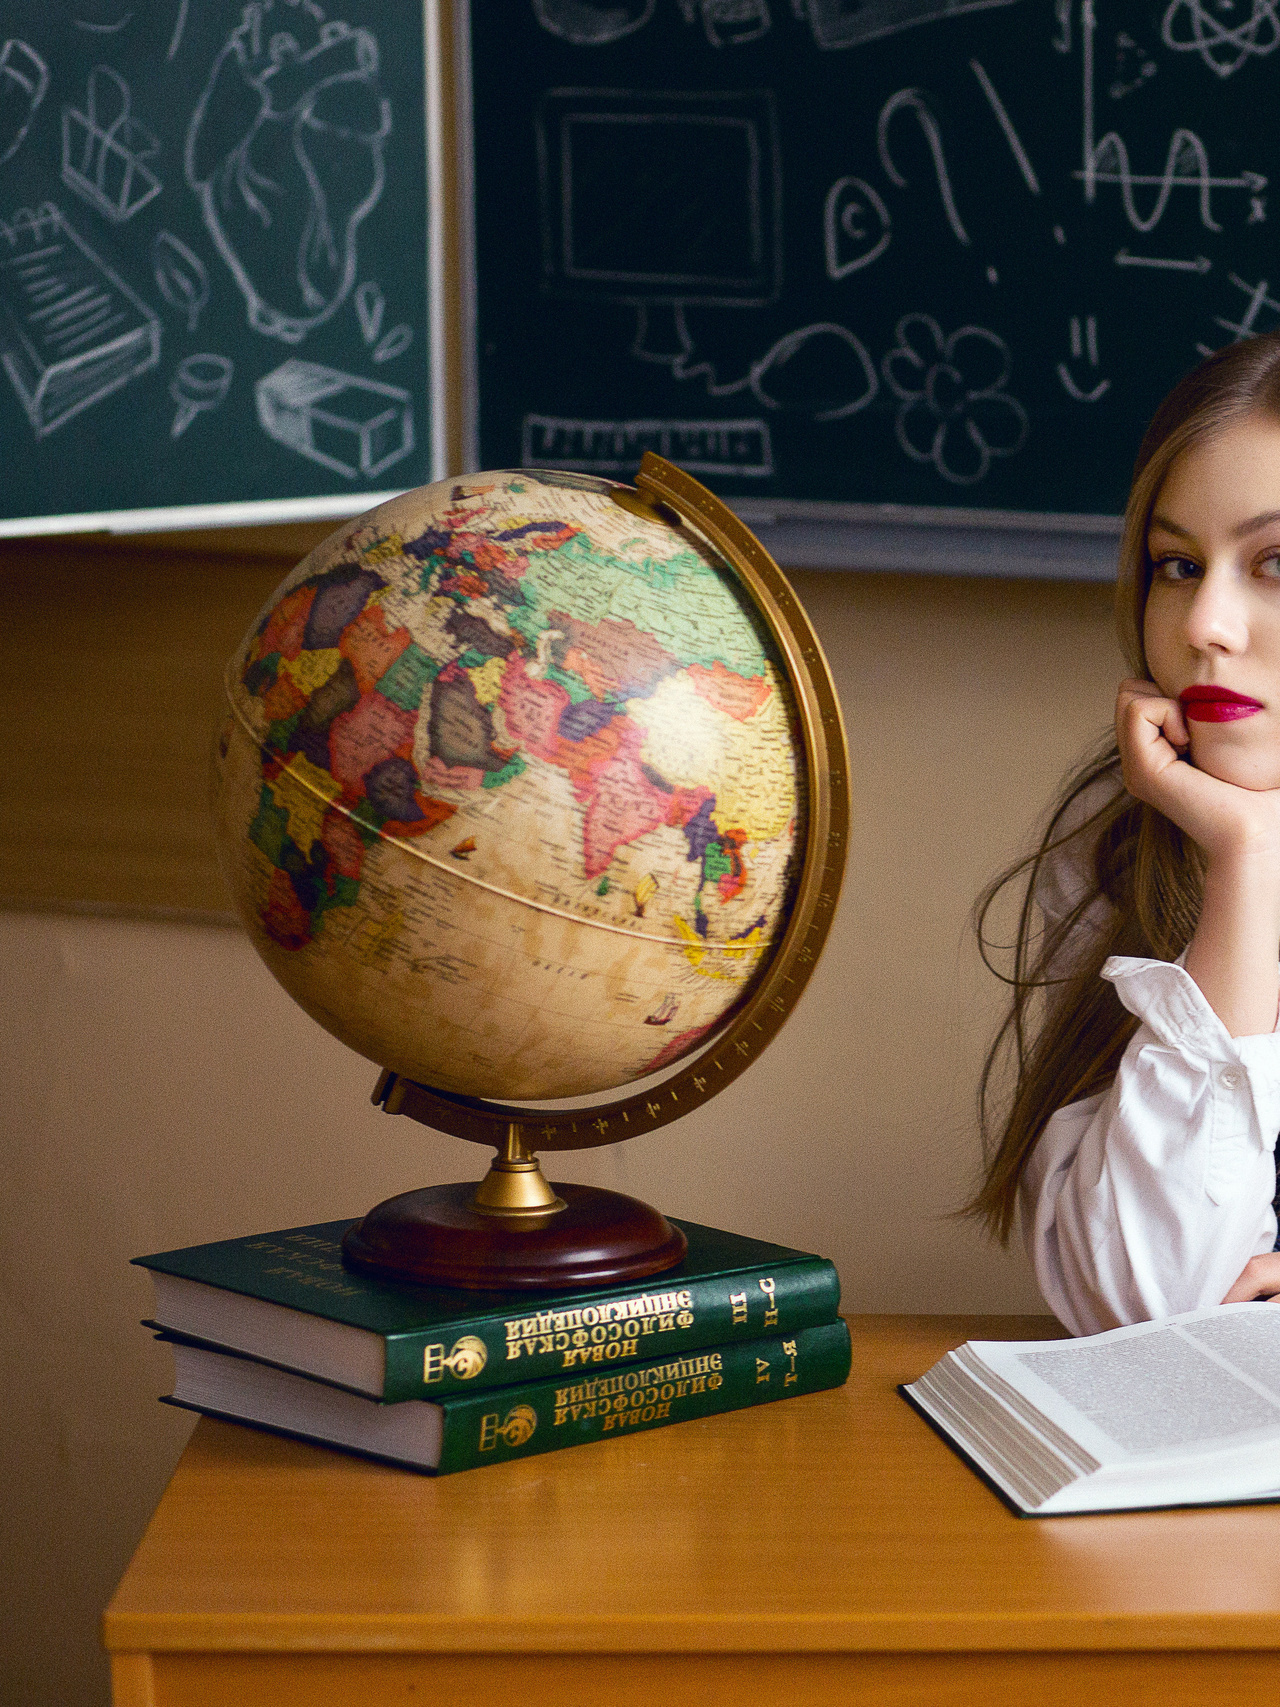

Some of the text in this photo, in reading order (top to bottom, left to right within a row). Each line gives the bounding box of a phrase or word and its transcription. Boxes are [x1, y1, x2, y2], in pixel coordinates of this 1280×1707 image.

[504, 1290, 693, 1340] ЭНЦИКЛОПЕДИЯ
[729, 1292, 748, 1325] III
[505, 1310, 694, 1360] ФИЛОСОФСКАЯ
[562, 1339, 639, 1367] НОВАЯ
[554, 1353, 723, 1407] ЭНЦИКЛОПЕДИЯ
[755, 1357, 771, 1384] IV
[553, 1373, 723, 1426] ФИЛОСОФСКАЯ
[602, 1402, 673, 1431] НОВАЯ
